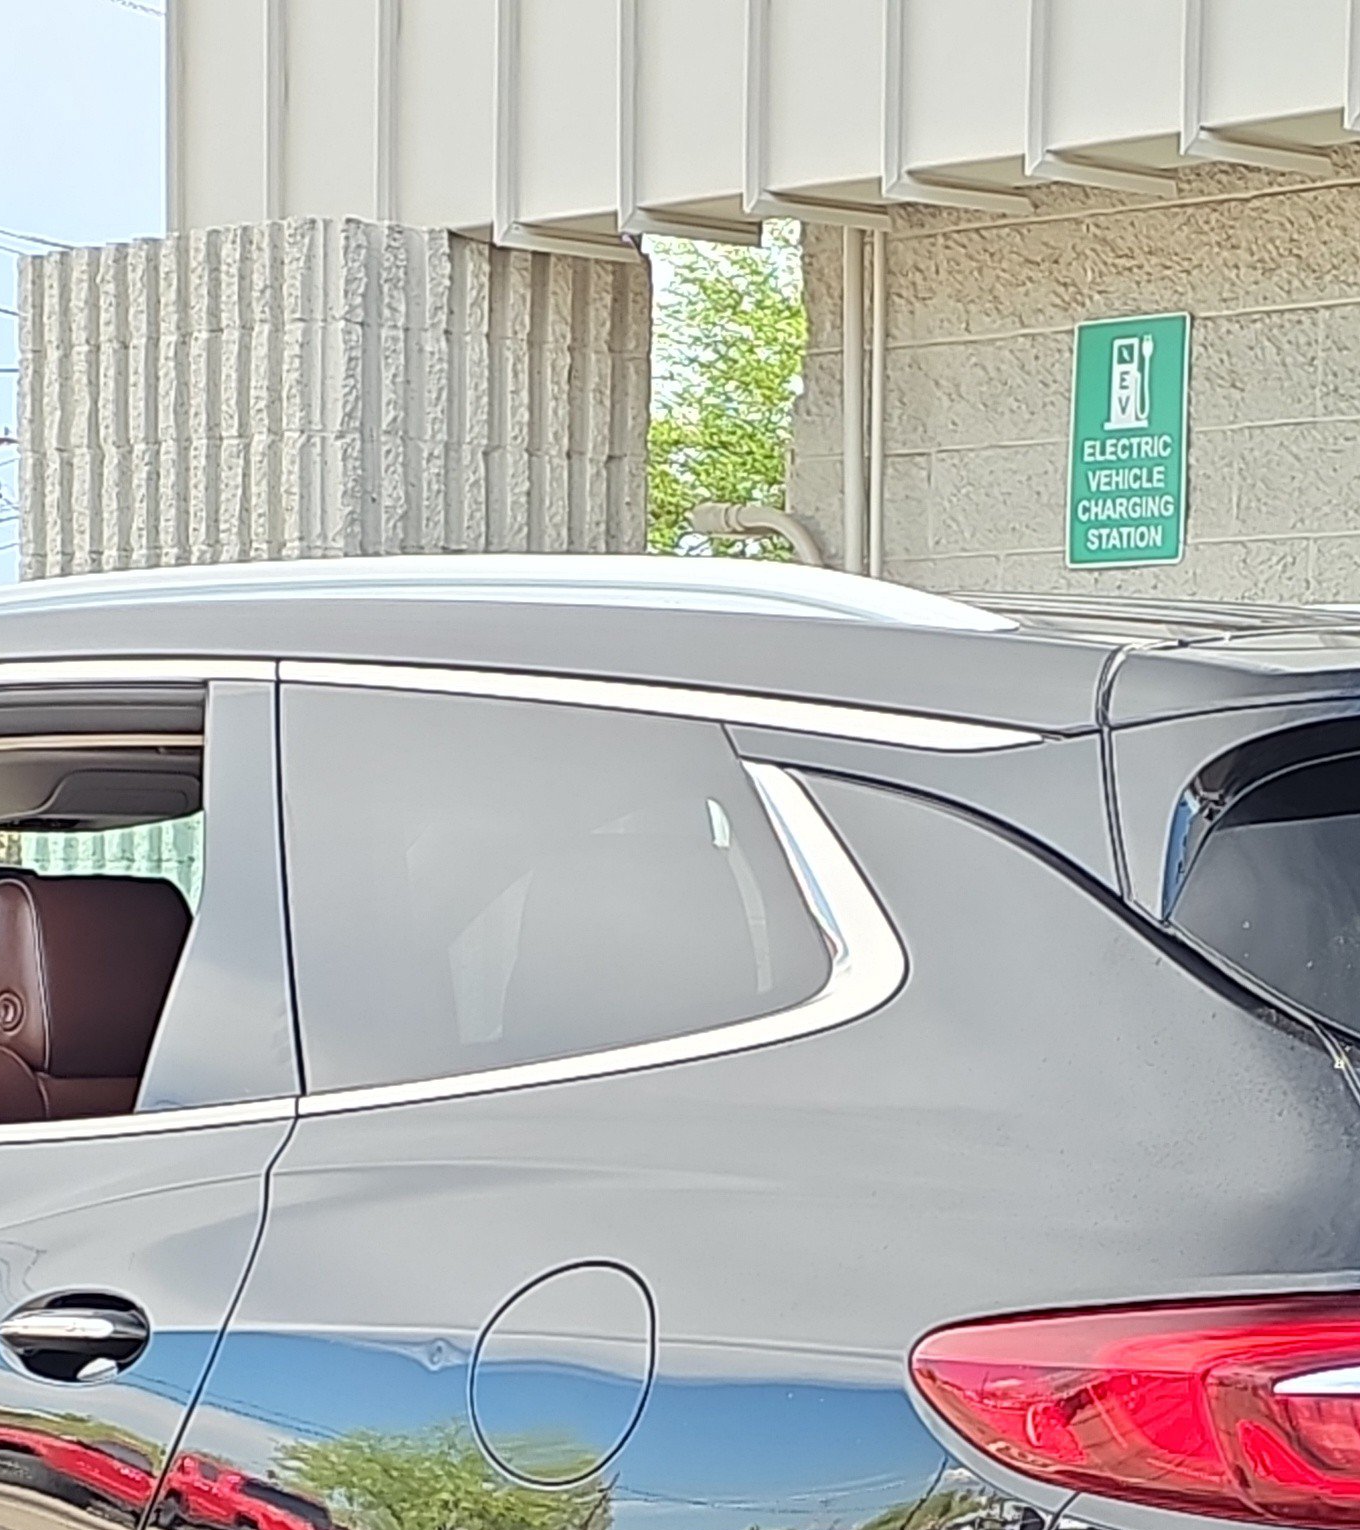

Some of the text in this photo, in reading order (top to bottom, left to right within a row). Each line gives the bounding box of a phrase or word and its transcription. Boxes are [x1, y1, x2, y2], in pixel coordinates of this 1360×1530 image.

[1083, 435, 1172, 462] ELECTRIC
[1088, 466, 1165, 492] VEHICLE
[1077, 495, 1174, 521] CHARGING
[1087, 525, 1162, 550] STATION
